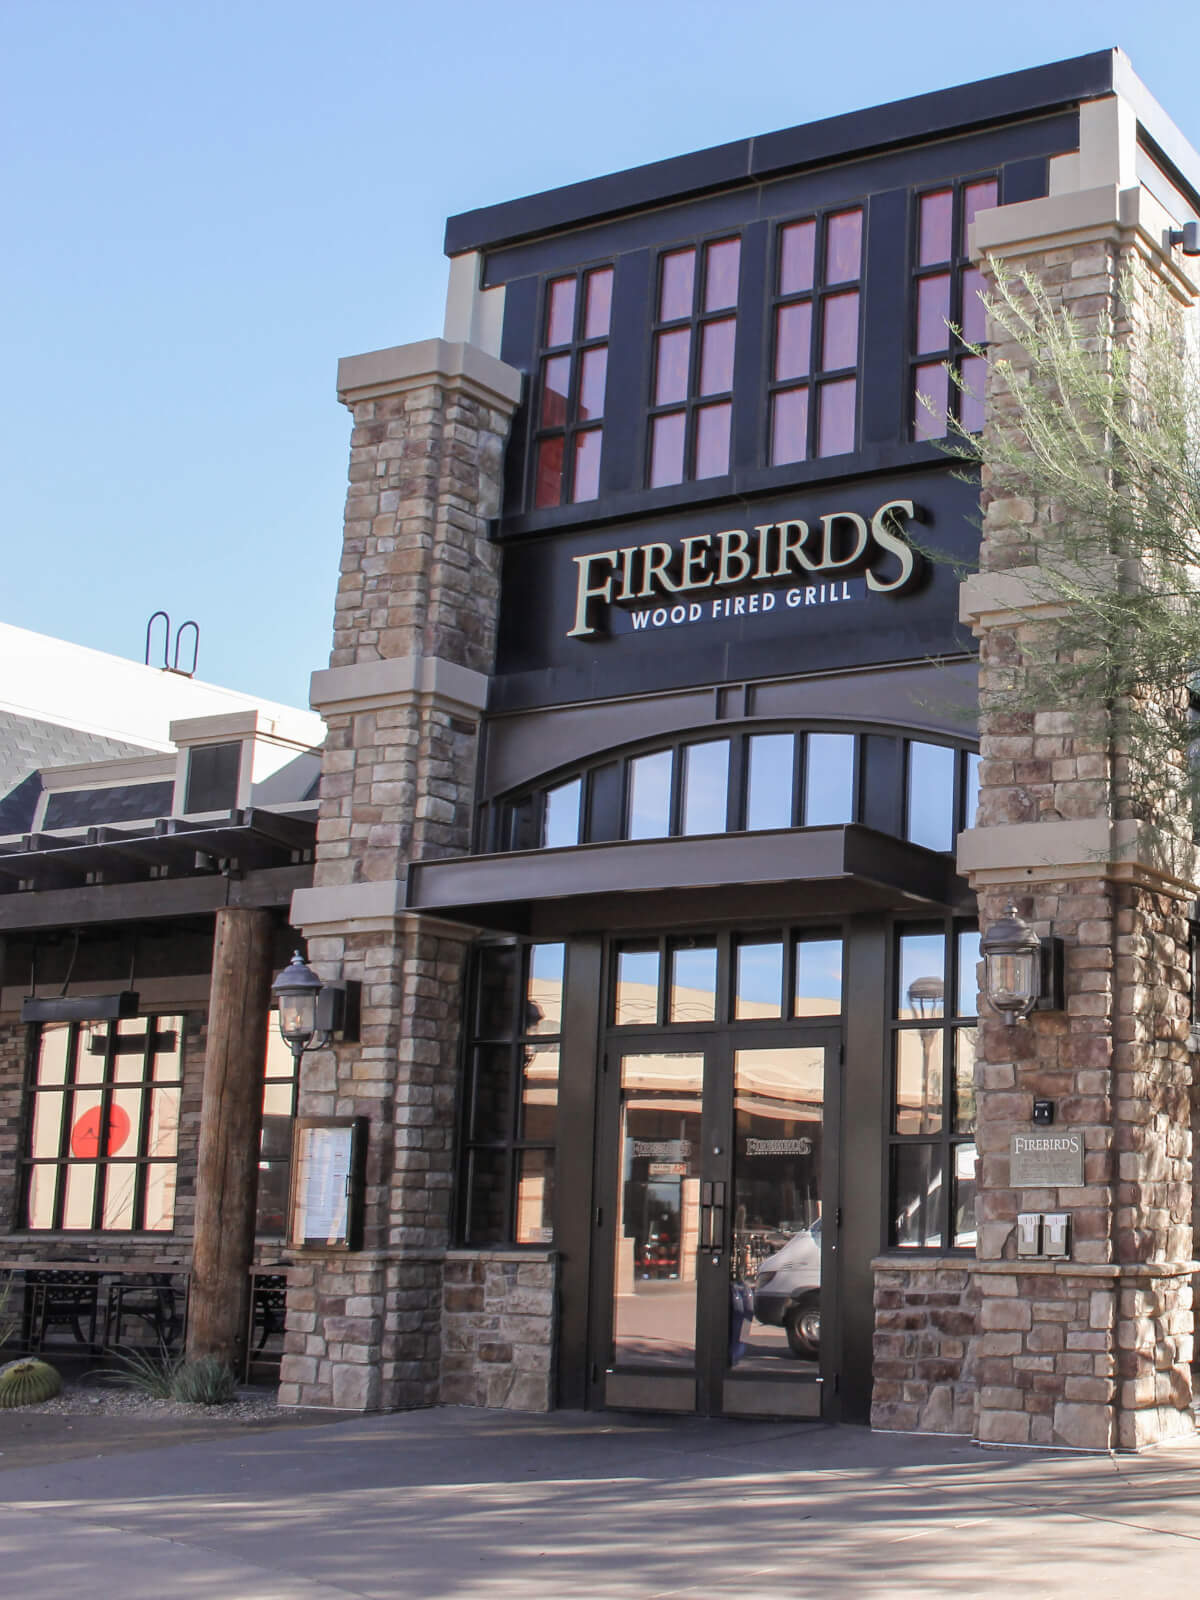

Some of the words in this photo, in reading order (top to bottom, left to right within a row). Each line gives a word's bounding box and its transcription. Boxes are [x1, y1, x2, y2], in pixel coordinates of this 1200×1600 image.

[566, 499, 915, 637] FIREBIRDS
[631, 603, 702, 630] WOOD
[711, 592, 775, 619] FIRED
[785, 581, 851, 608] GRILL
[1015, 1136, 1079, 1154] FIREBIRDS
